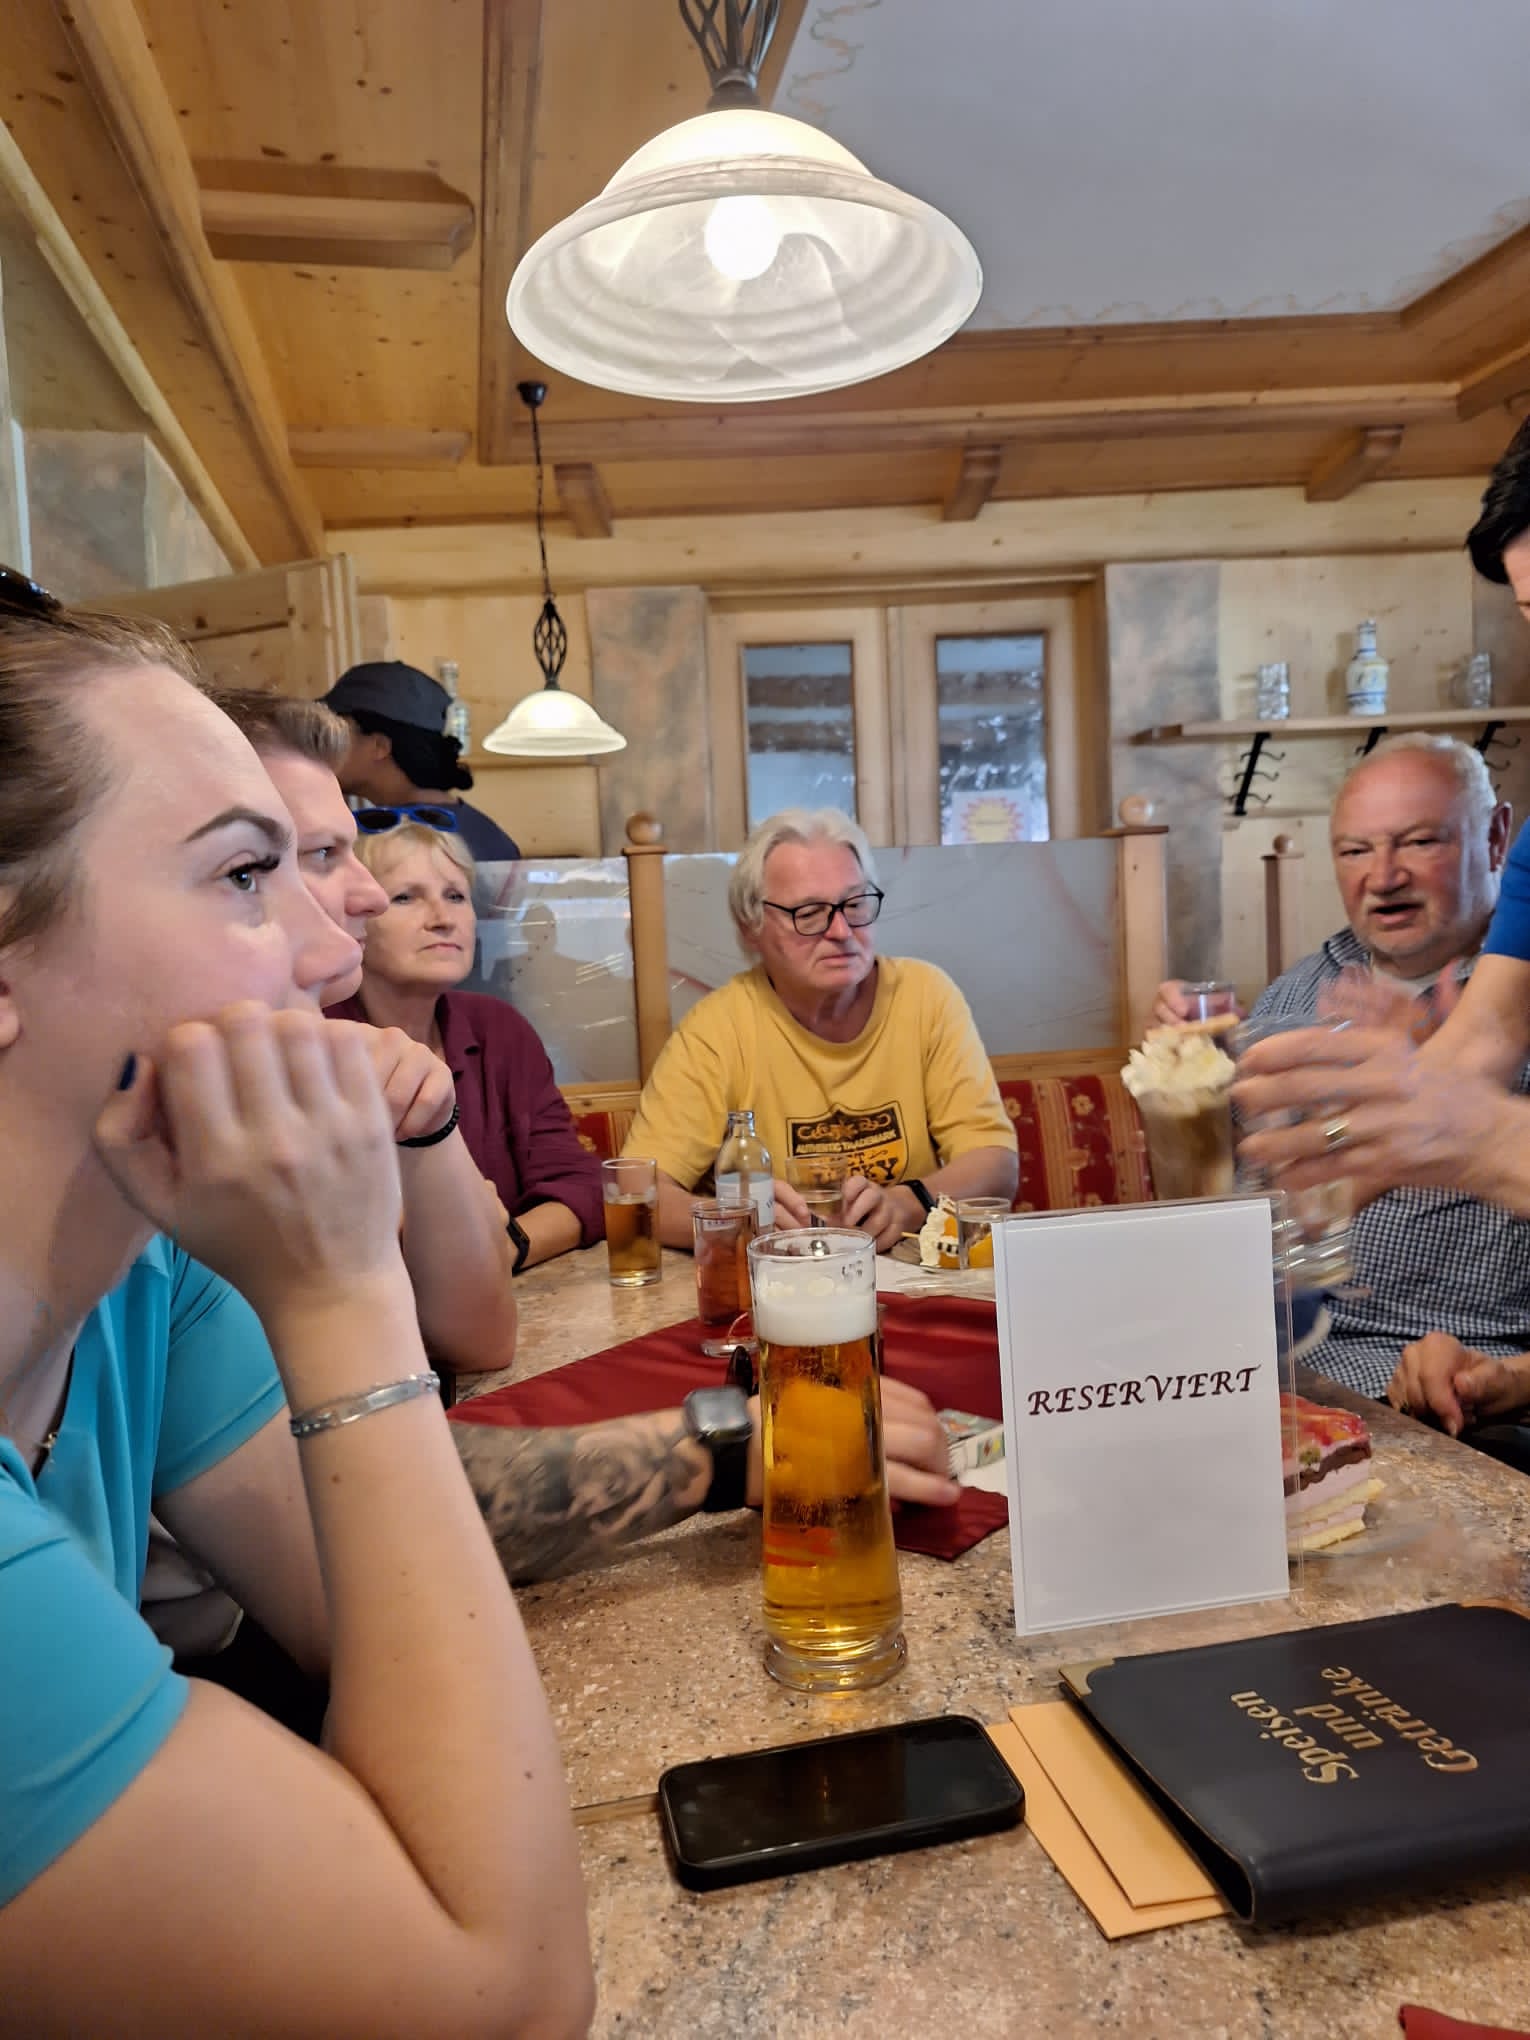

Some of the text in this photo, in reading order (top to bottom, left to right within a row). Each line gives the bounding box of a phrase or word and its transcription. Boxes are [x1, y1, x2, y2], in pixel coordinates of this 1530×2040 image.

[1028, 1364, 1261, 1416] RESERVIERT
[1230, 1690, 1359, 1784] Speisen
[1293, 1702, 1384, 1750] und
[1321, 1665, 1479, 1773] Getränke
